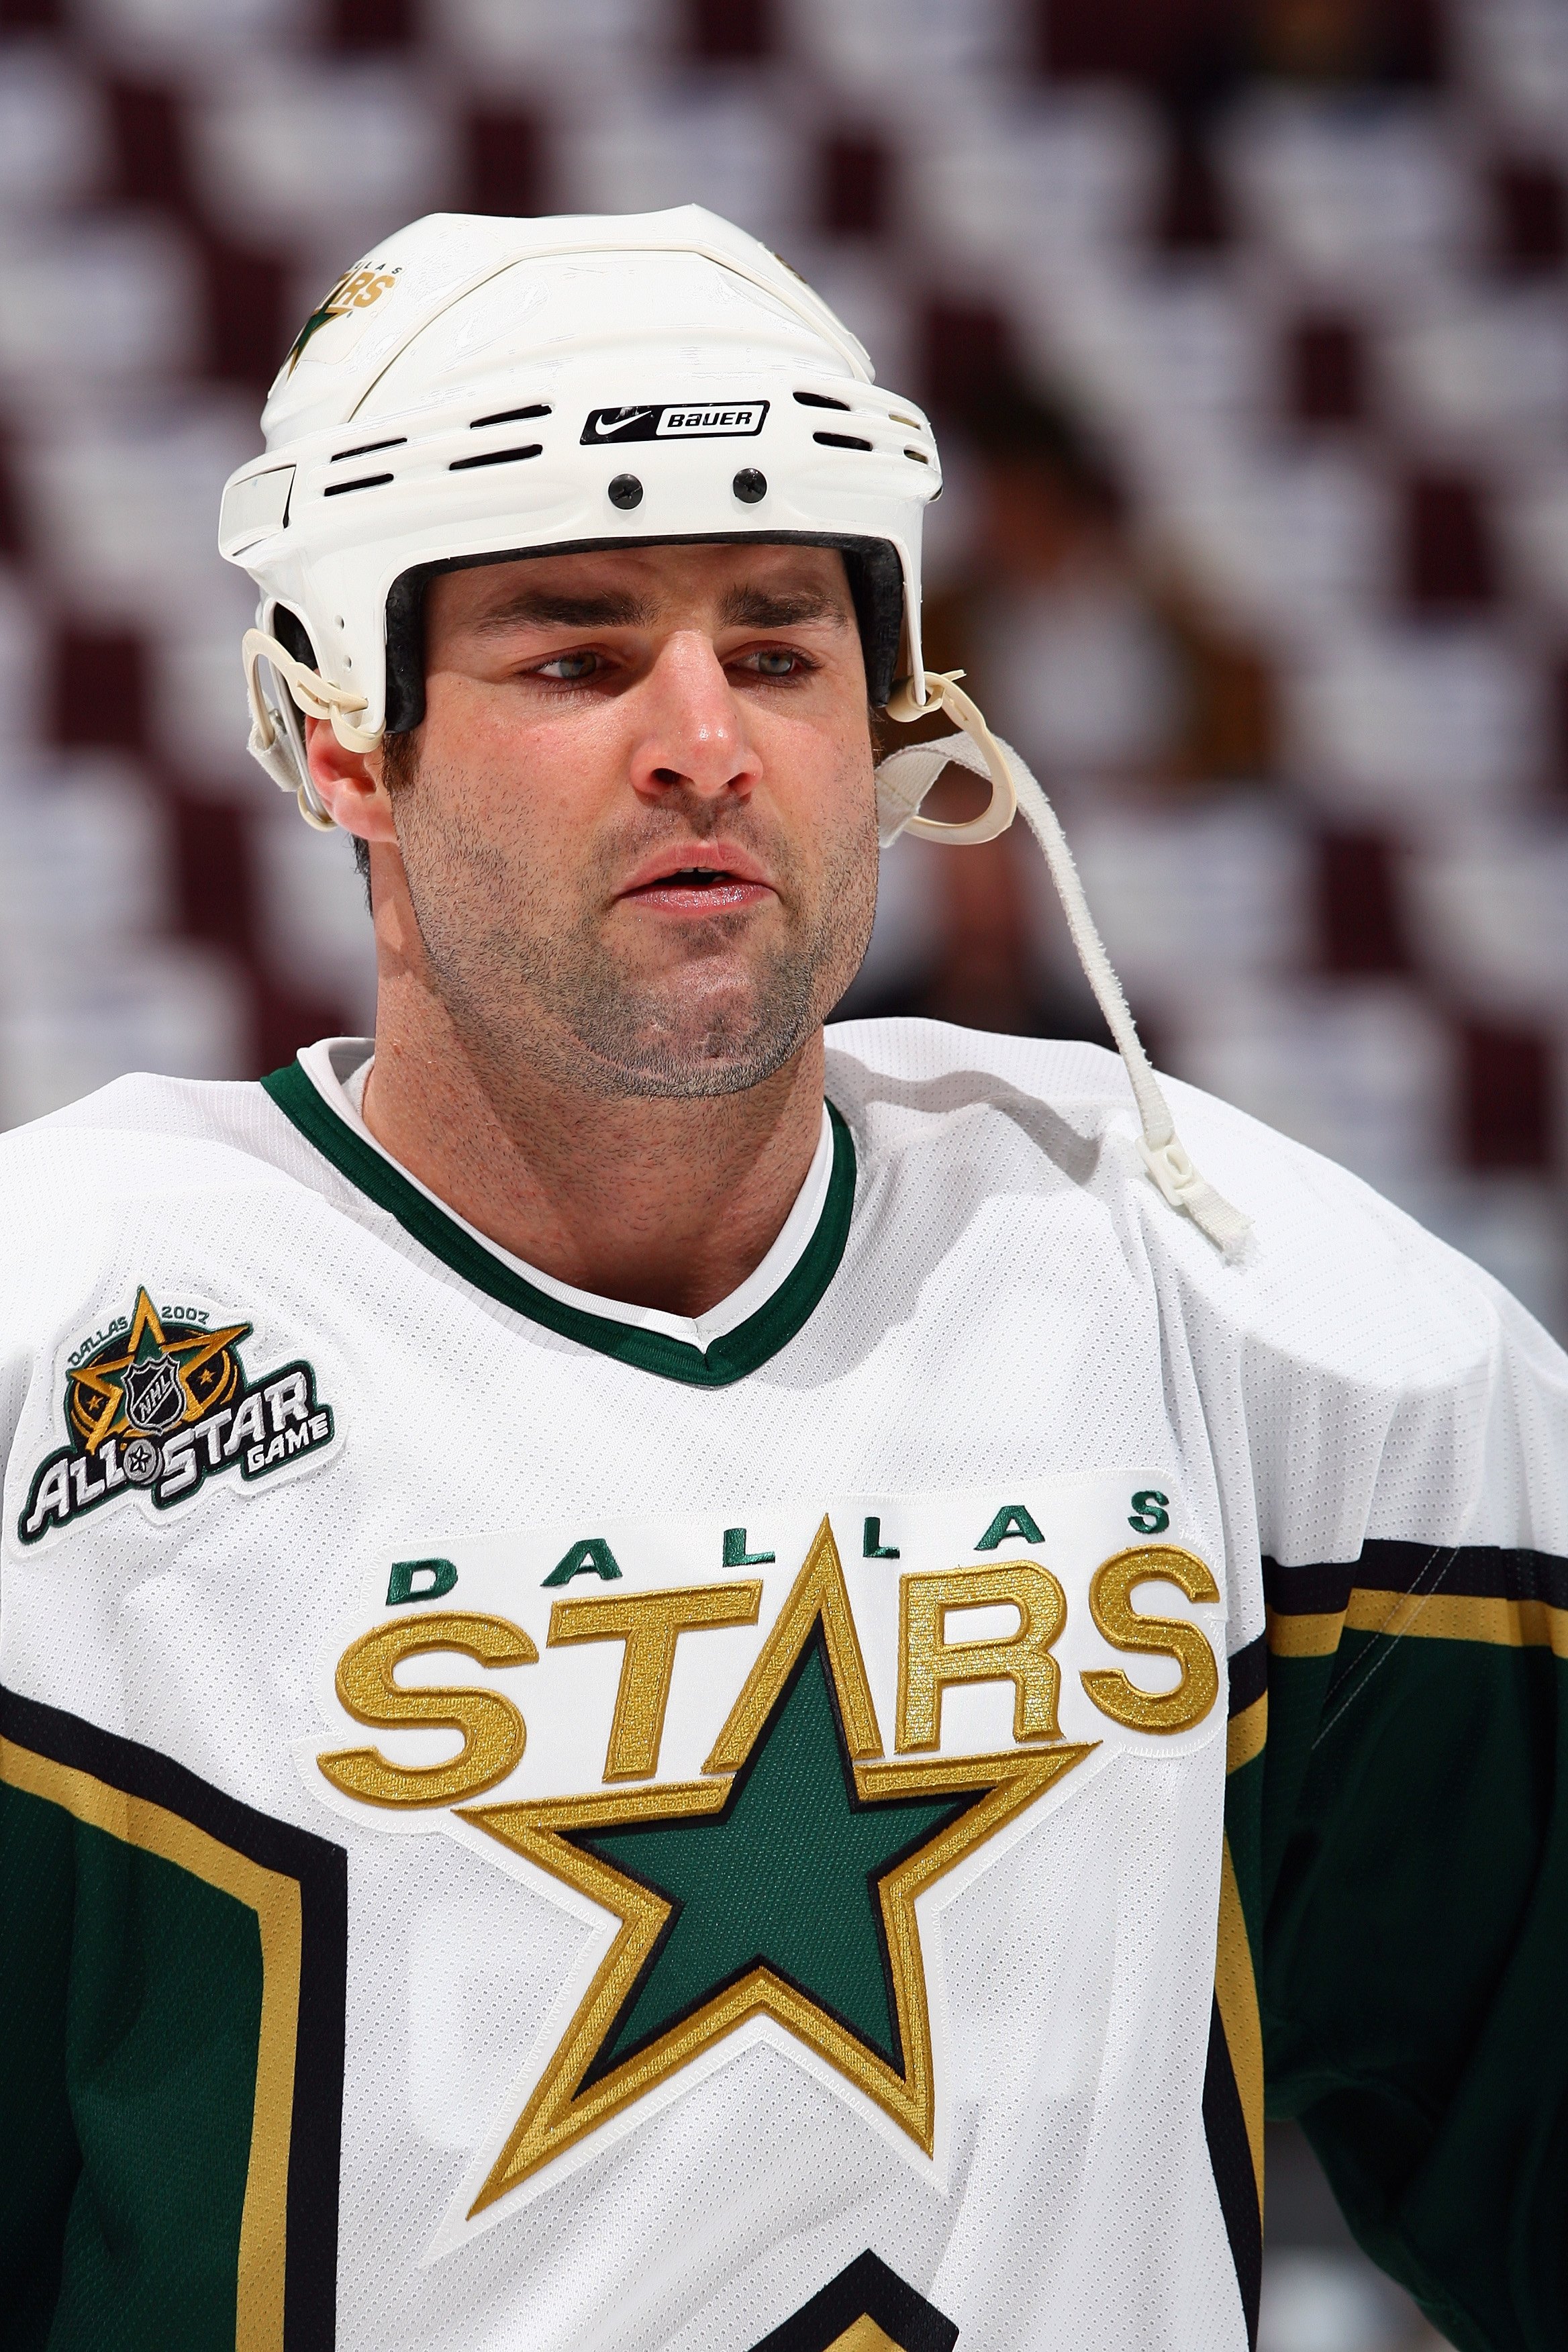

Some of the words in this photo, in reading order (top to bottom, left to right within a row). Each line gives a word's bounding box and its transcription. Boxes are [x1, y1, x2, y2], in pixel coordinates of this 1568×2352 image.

[68, 1316, 128, 1366] DALLAS
[162, 1306, 209, 1325] 2007
[140, 1375, 170, 1422] NHL
[248, 1412, 329, 1474] GAME
[27, 1438, 126, 1534] ALL
[160, 1371, 309, 1498] STAR
[385, 1489, 1170, 1606] DALLAS
[317, 1512, 1220, 1810] STARS
